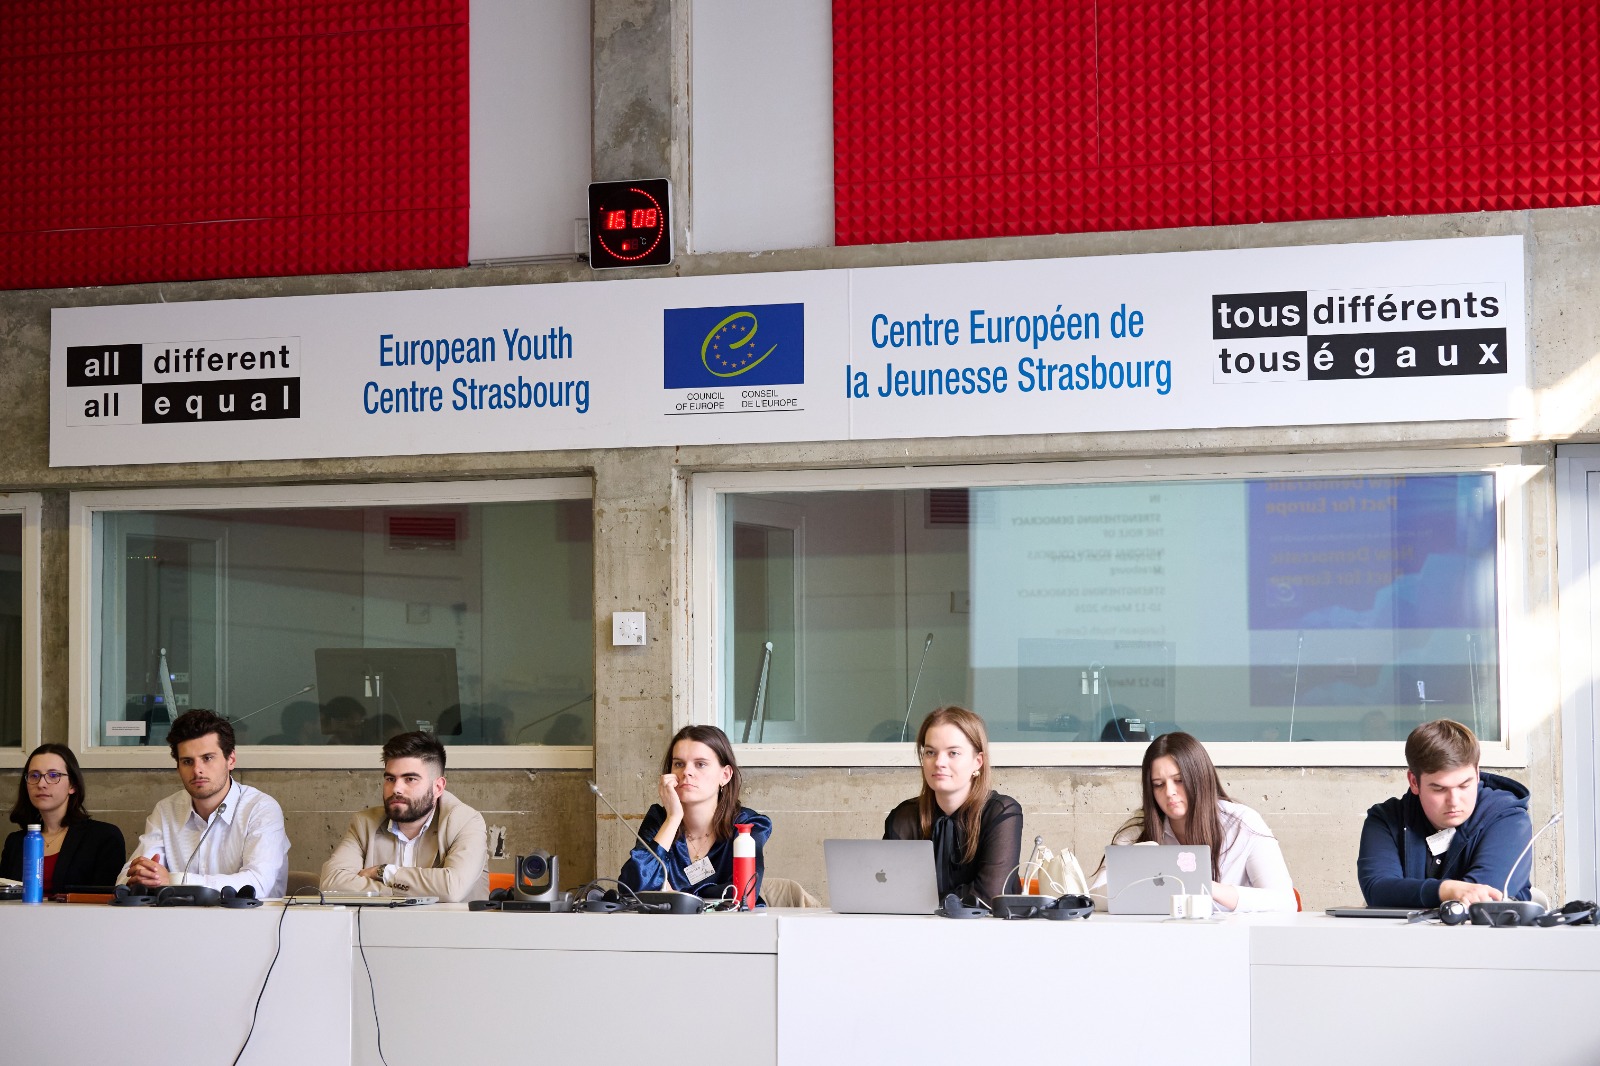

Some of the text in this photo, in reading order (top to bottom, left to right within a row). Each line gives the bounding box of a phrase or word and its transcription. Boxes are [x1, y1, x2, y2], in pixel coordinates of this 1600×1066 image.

[871, 303, 1144, 350] Centre Européen de
[1218, 291, 1500, 329] tous différents
[84, 344, 290, 378] all different
[379, 326, 573, 372] European Youth
[1218, 341, 1500, 376] tous égaux
[741, 389, 779, 399] CONSEIL
[846, 355, 1172, 399] la Jeunesse Strasbourg
[84, 385, 290, 420] all equal
[363, 375, 590, 415] Centre Strasbourg
[675, 402, 725, 411] OF EUROPE
[686, 392, 725, 401] COUNCIL
[741, 398, 798, 408] DE L'EUROPE
